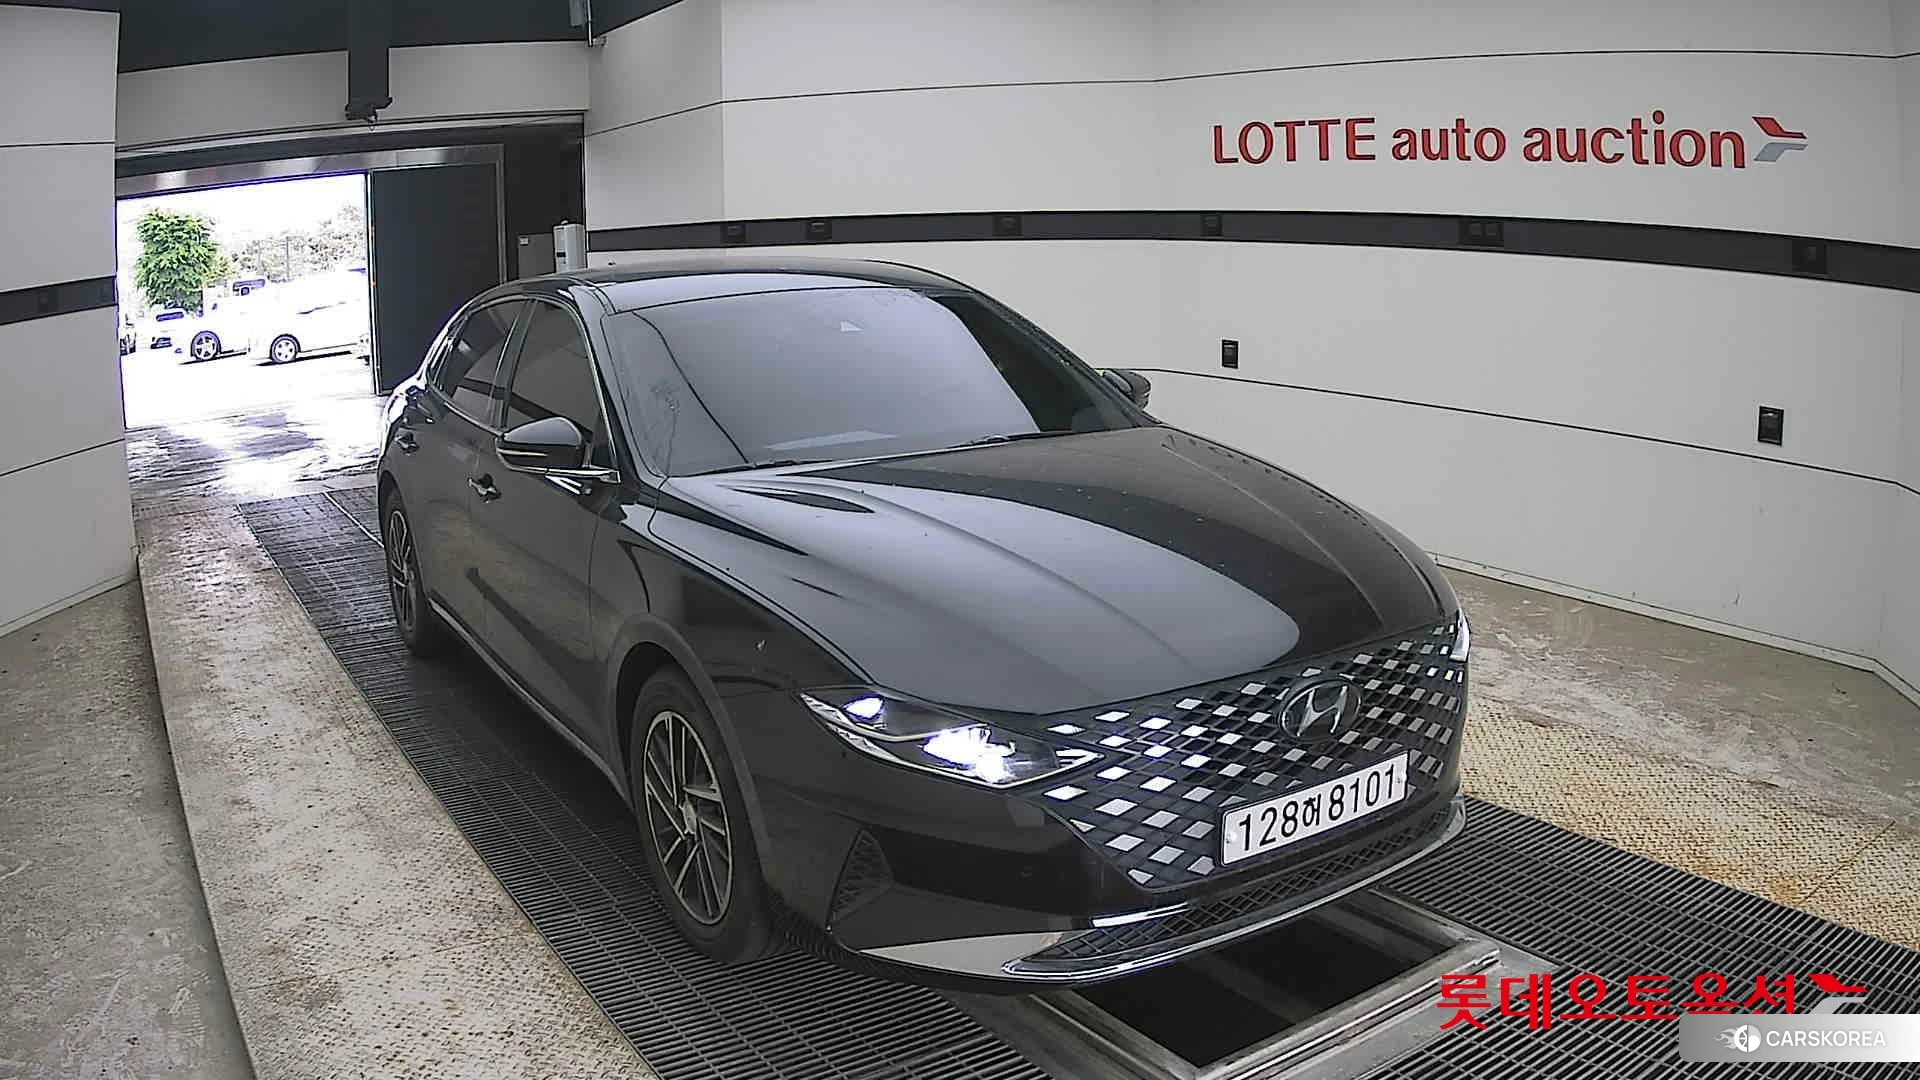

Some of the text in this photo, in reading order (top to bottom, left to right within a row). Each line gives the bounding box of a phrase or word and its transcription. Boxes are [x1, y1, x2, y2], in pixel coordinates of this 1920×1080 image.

[1213, 110, 1747, 169] LOTTE auto auction
